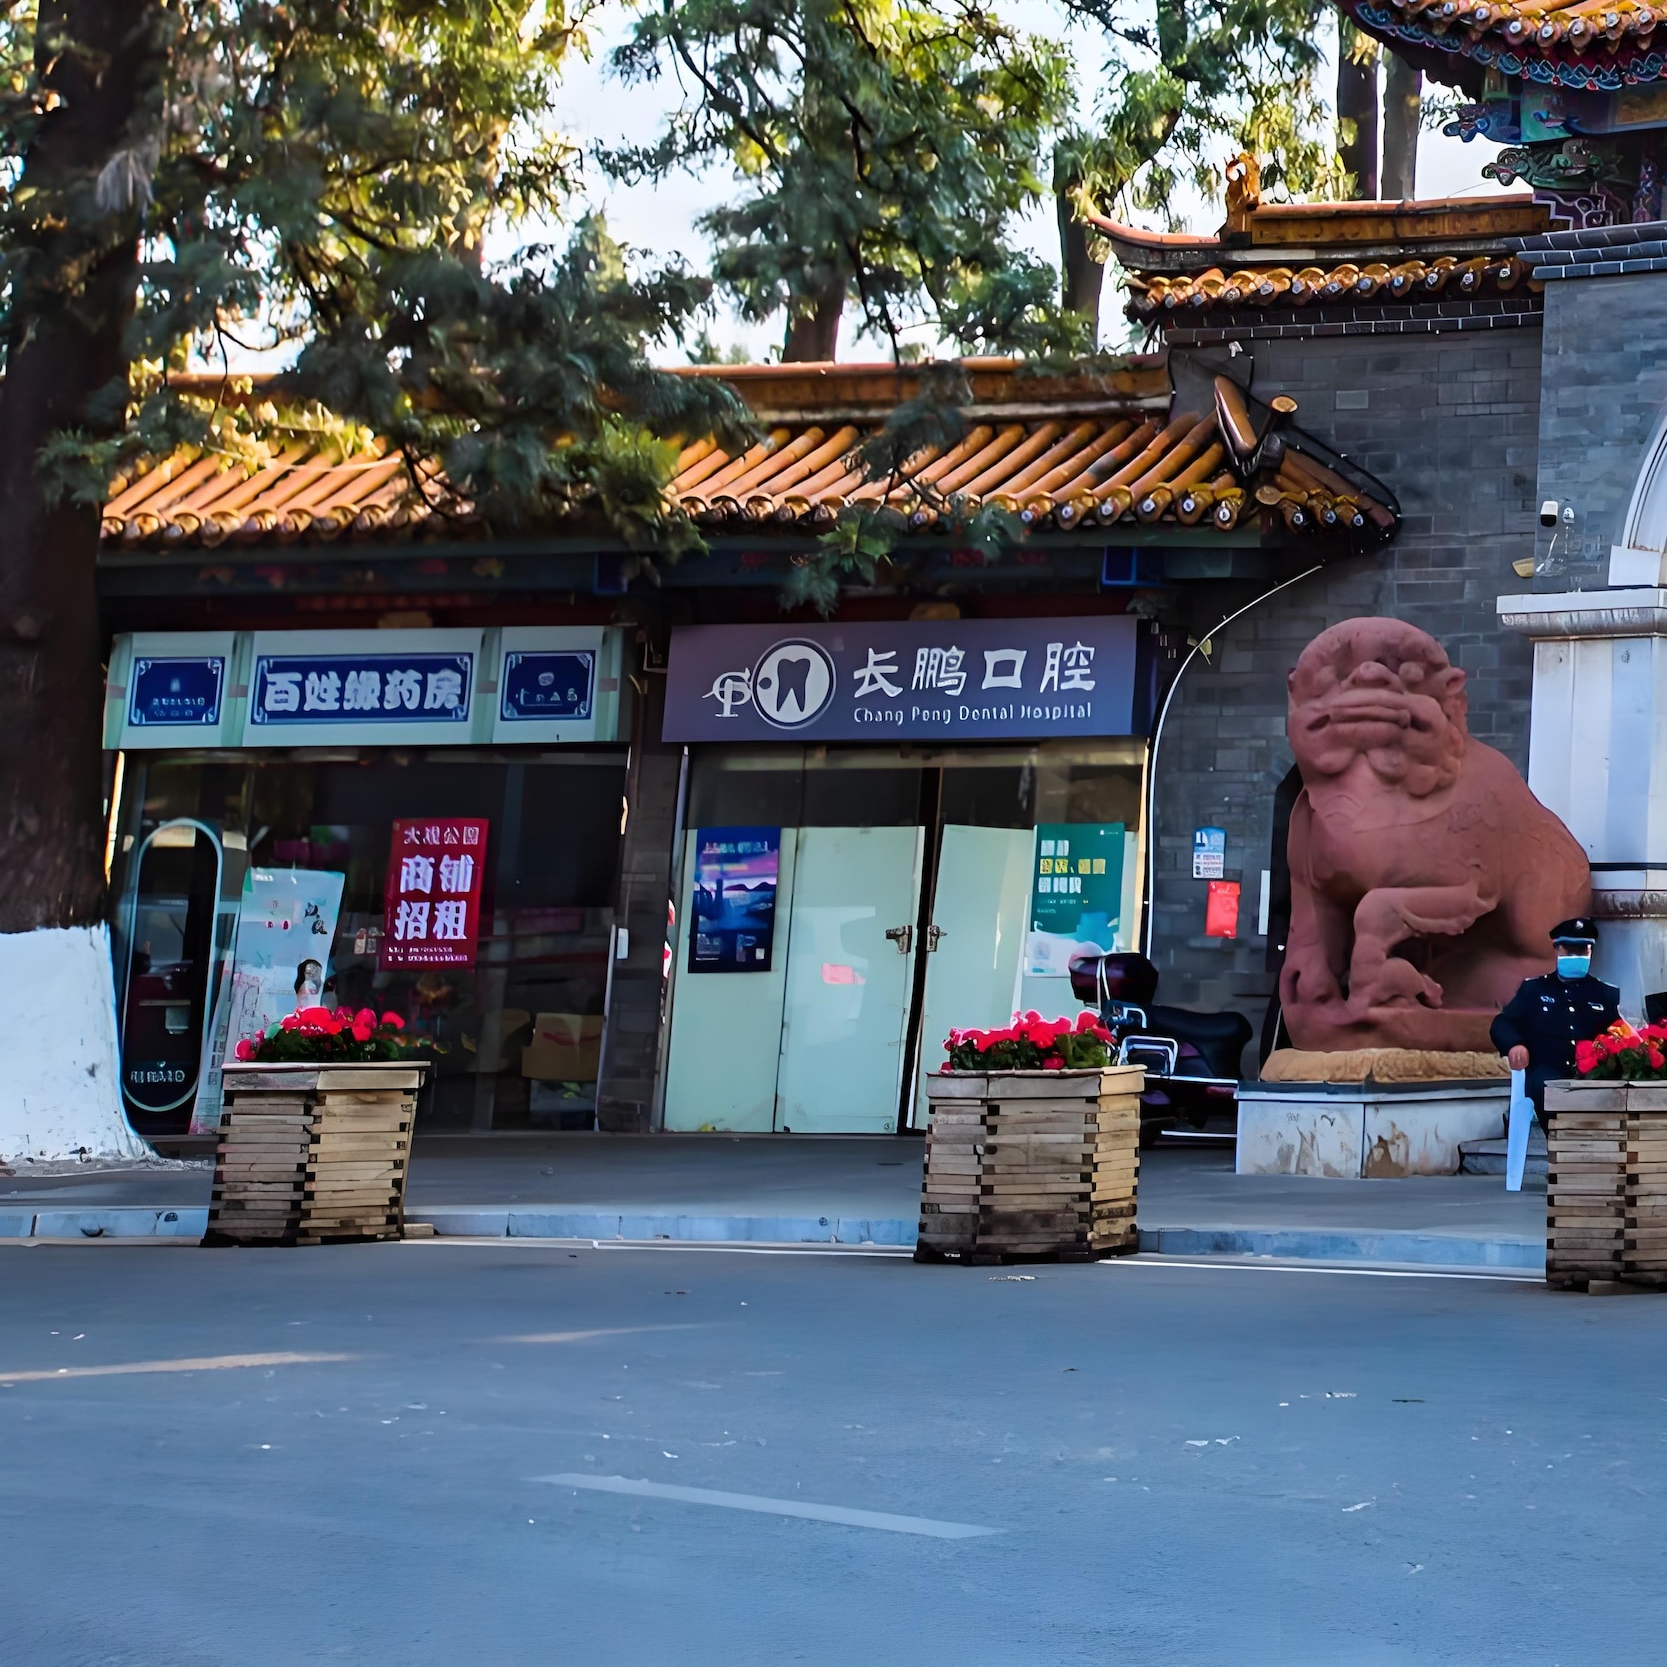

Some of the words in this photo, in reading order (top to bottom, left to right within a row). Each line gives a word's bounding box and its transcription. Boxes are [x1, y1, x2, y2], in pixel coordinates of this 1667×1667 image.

[853, 640, 1096, 698] 长鹏口腔
[853, 707, 904, 726] Chang
[959, 704, 1014, 721] Dental
[1020, 702, 1092, 721] Hospital
[394, 899, 468, 941] 招租
